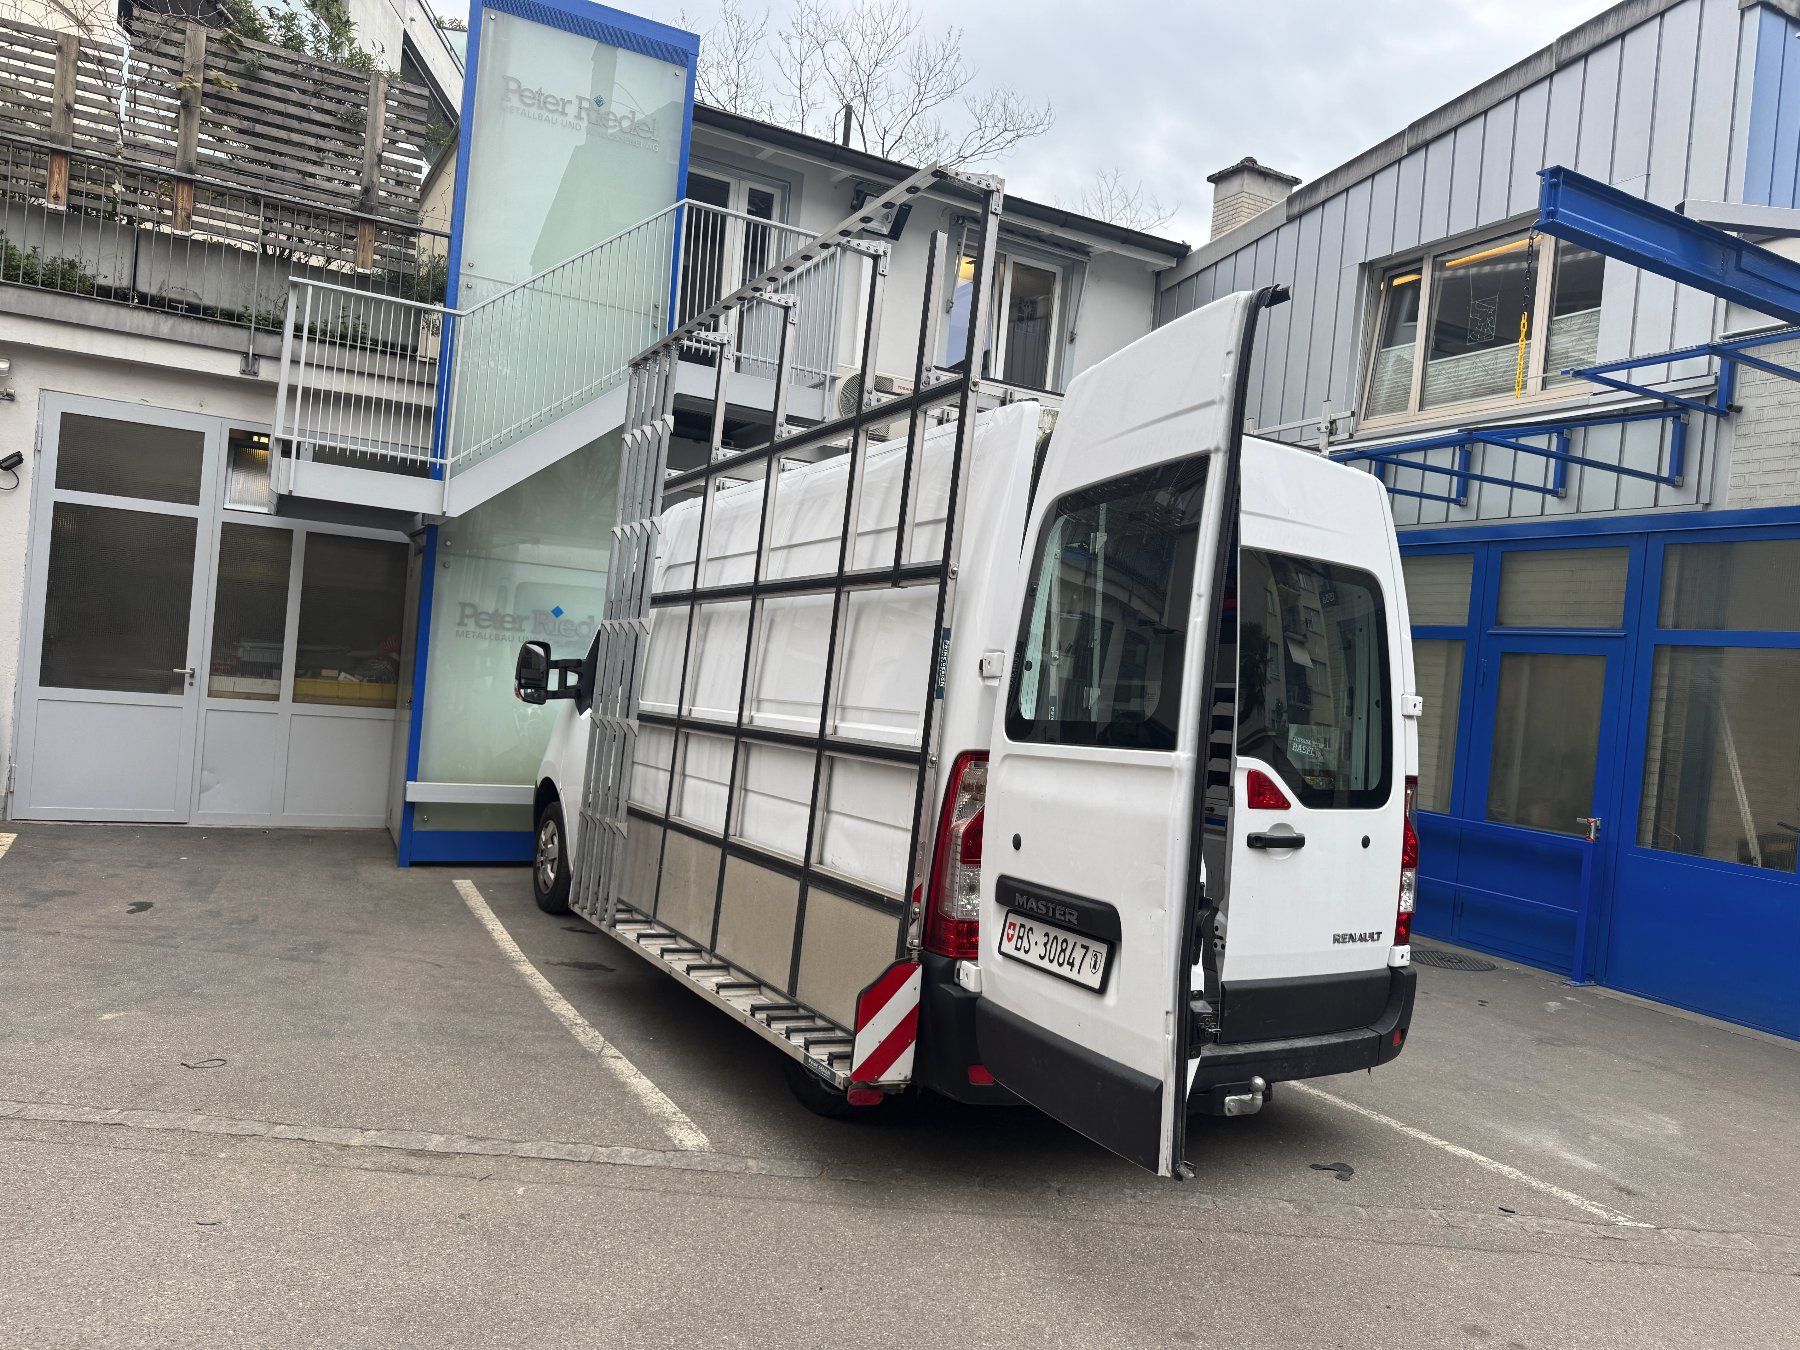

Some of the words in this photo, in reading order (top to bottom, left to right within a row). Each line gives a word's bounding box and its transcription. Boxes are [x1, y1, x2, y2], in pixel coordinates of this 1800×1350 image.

[502, 74, 572, 117] Peter
[574, 94, 659, 141] Riedel
[561, 119, 582, 131] UND
[456, 601, 530, 633] Peter
[531, 604, 595, 639] Ried
[455, 629, 515, 642] METALLBAU
[1015, 892, 1079, 925] MASTER
[1332, 931, 1383, 944] RENAULT
